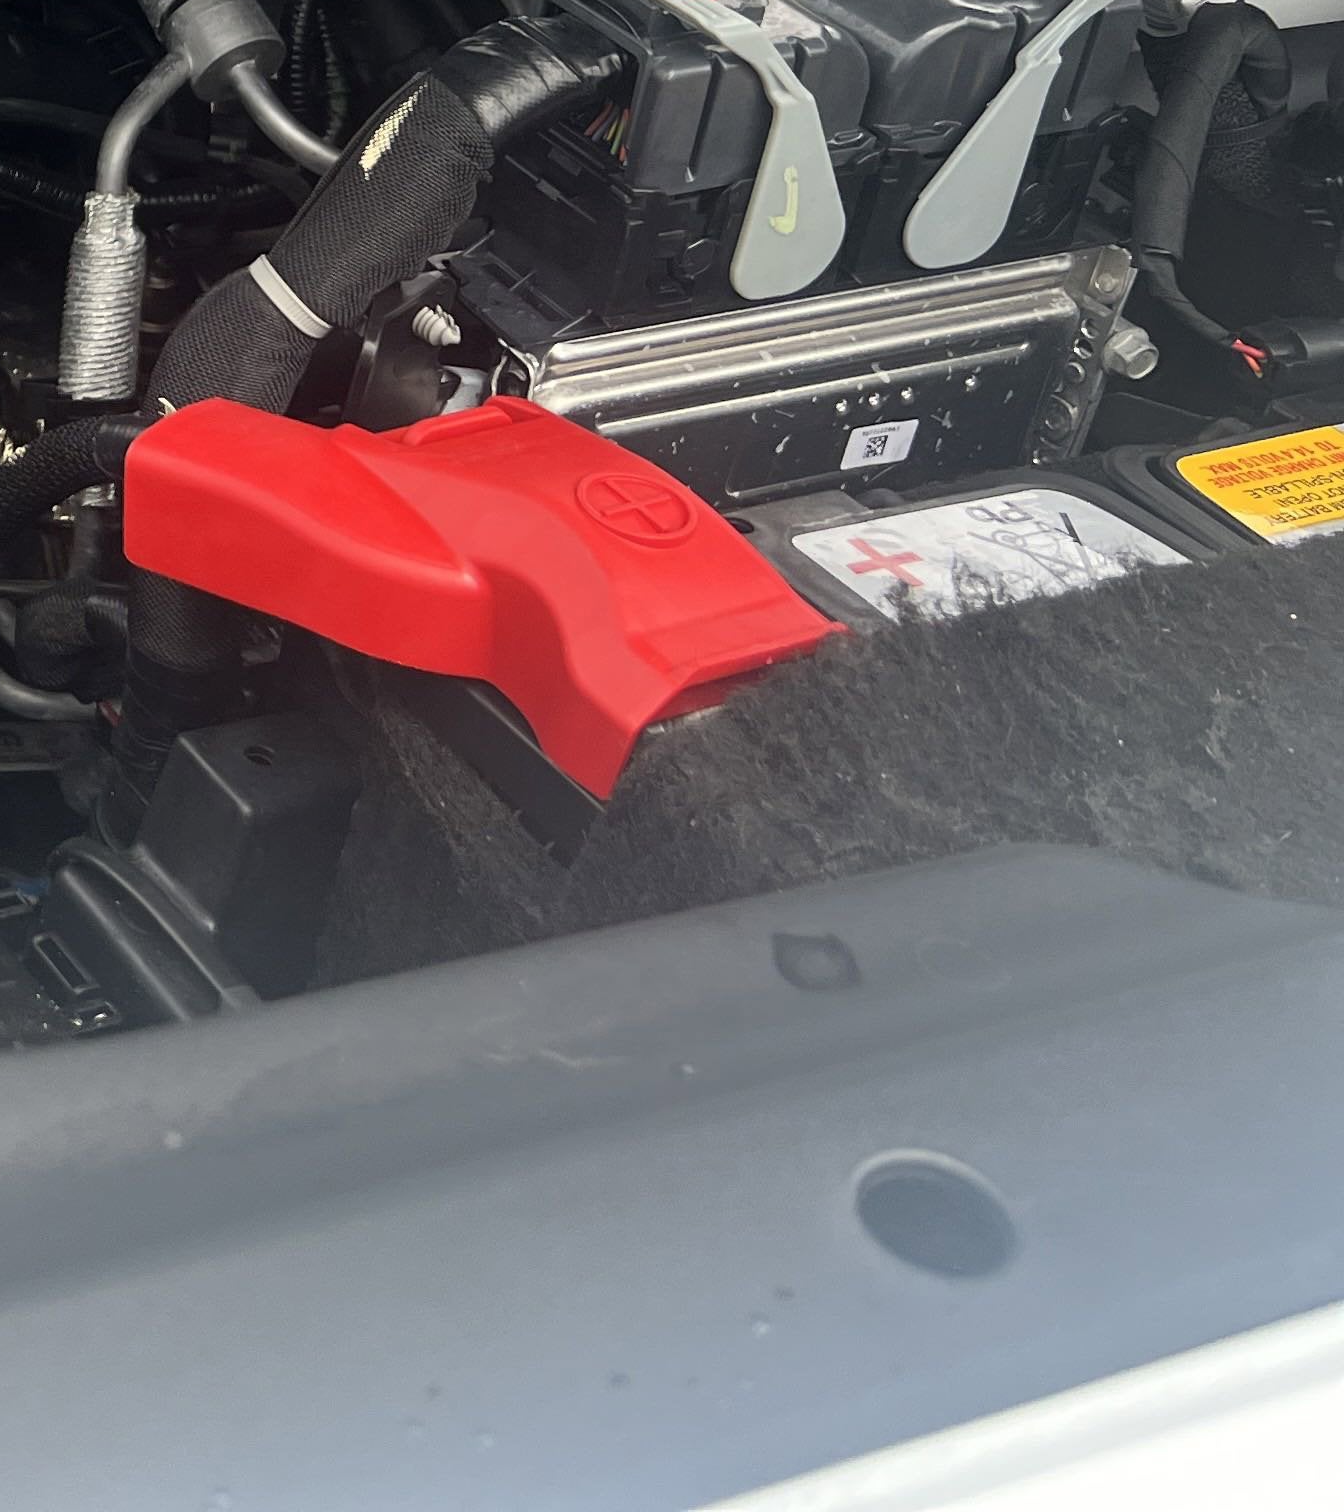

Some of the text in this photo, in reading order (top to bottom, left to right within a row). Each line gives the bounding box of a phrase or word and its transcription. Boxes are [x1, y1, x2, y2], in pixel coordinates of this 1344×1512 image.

[1313, 440, 1341, 451] TO
[1237, 452, 1283, 469] VOLTS
[1267, 457, 1328, 476] CHARGE
[1207, 469, 1272, 489] VOLTAGE
[1264, 503, 1332, 526] BATTERY
